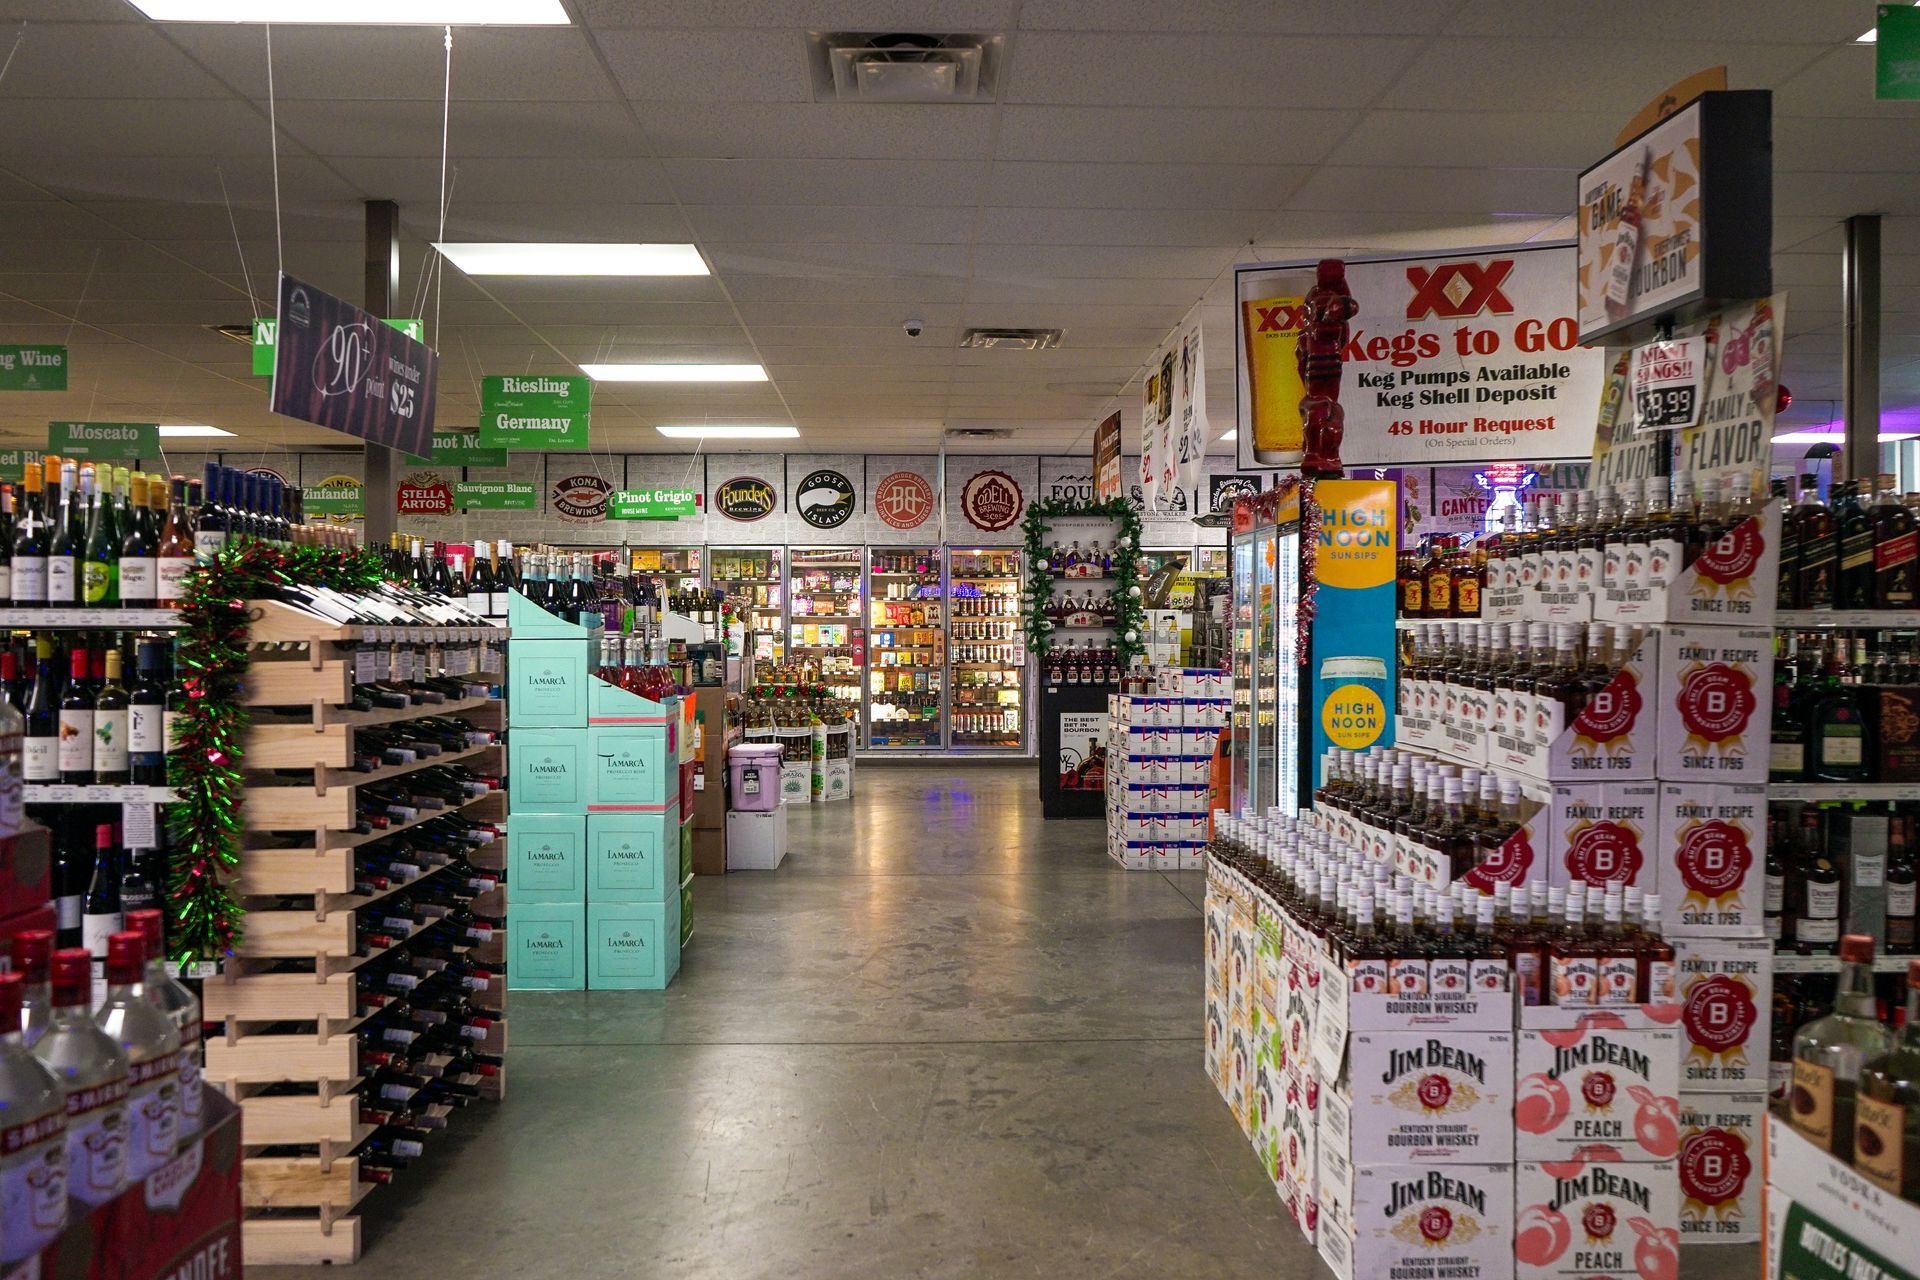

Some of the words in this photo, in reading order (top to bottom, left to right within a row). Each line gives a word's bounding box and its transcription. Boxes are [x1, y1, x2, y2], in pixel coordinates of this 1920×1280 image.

[1406, 260, 1514, 321] XX
[1453, 326, 1500, 356] to
[20, 351, 61, 366] Wine
[1358, 372, 1395, 390] Keg
[1401, 370, 1470, 387] Pumps
[1476, 363, 1570, 382] Available
[503, 378, 570, 397] Riesling
[390, 379, 414, 418] $25
[1377, 391, 1414, 409] Keg
[1420, 388, 1469, 405] Shell
[1476, 384, 1557, 404] Deposit
[497, 414, 571, 433] Germany
[1387, 421, 1413, 435] 48
[1420, 419, 1468, 434] Hour
[1473, 416, 1555, 434] Request
[68, 424, 139, 440] Moscato
[1446, 437, 1477, 448] Special
[570, 478, 598, 487] KONA
[808, 476, 844, 488] GOOSE
[877, 474, 912, 499] BRECKENRIDGE
[914, 475, 932, 499] BREWERY
[1219, 477, 1243, 489] Brewing
[303, 488, 359, 499] Zinfandel
[402, 490, 445, 499] STELLA
[457, 484, 504, 495] Sauvignon
[507, 484, 532, 493] Blanc
[978, 485, 1010, 506] ODELL
[402, 500, 446, 509] ARTOIS
[618, 491, 650, 504] Pinot
[654, 490, 693, 505] Grigio
[559, 501, 598, 516] BREWING
[978, 503, 1010, 514] BREWING
[807, 510, 845, 524] ISLAND
[887, 517, 900, 527] ALES
[1323, 510, 1385, 526] HIGH
[1319, 531, 1389, 547] NOON
[1692, 599, 1722, 612] SINCE
[1727, 600, 1751, 613] 1795
[1679, 648, 1716, 661] FAMILY
[1723, 650, 1758, 662] RECIPE
[1334, 703, 1374, 714] HIGH
[1594, 692, 1613, 713] B
[1707, 691, 1726, 713] B
[1332, 718, 1376, 728] NOON
[1571, 757, 1603, 769] SINCE
[1607, 757, 1632, 769] 1795
[1682, 756, 1715, 769] SINCE
[1719, 757, 1744, 770] 1795
[1566, 807, 1602, 819] FAMILY
[1608, 807, 1644, 819] RECIPE
[1676, 806, 1713, 818] FAMILY
[1718, 806, 1754, 818] RECIPE
[1595, 849, 1614, 870] B
[1705, 848, 1724, 869] B
[1682, 912, 1713, 925] SINCE
[1718, 912, 1742, 925] 1795
[1681, 960, 1717, 973] FAMILY
[1722, 961, 1759, 973] RECIPE
[1434, 992, 1466, 1001] STRAIGHT
[1386, 1002, 1431, 1014] BOURBON
[1435, 1002, 1478, 1014] WHISKEY
[1709, 1003, 1728, 1024] B
[1382, 1043, 1423, 1084] JIM
[1427, 1039, 1486, 1084] BEAM
[1548, 1045, 1588, 1079] JIM
[1592, 1036, 1650, 1081] BEAM
[1686, 1067, 1718, 1080] SINCE
[1721, 1068, 1746, 1080] 1795
[1680, 1114, 1711, 1126] AMILY
[1716, 1114, 1752, 1127] RECIPE
[1400, 1124, 1434, 1133] KENTUCKY
[1436, 1124, 1468, 1133] STRAIGHT
[1574, 1120, 1622, 1137] PEACH
[1388, 1135, 1432, 1146] BOURBON
[1436, 1135, 1480, 1146] WHISKEY
[1704, 1155, 1722, 1177] B
[1384, 1180, 1424, 1217] JIM
[1427, 1171, 1487, 1216] BEAM
[1549, 1176, 1588, 1212] JIM
[1592, 1167, 1650, 1213] BEAM
[1680, 1221, 1712, 1233] SINCE
[1716, 1221, 1740, 1233] 1795
[1402, 1257, 1435, 1266] KENTUCKY
[1438, 1257, 1469, 1265] STRAIGHT
[1576, 1252, 1622, 1268] PEACH
[1390, 1267, 1434, 1279] BOURBON
[1437, 1267, 1480, 1279] WHISKEY
